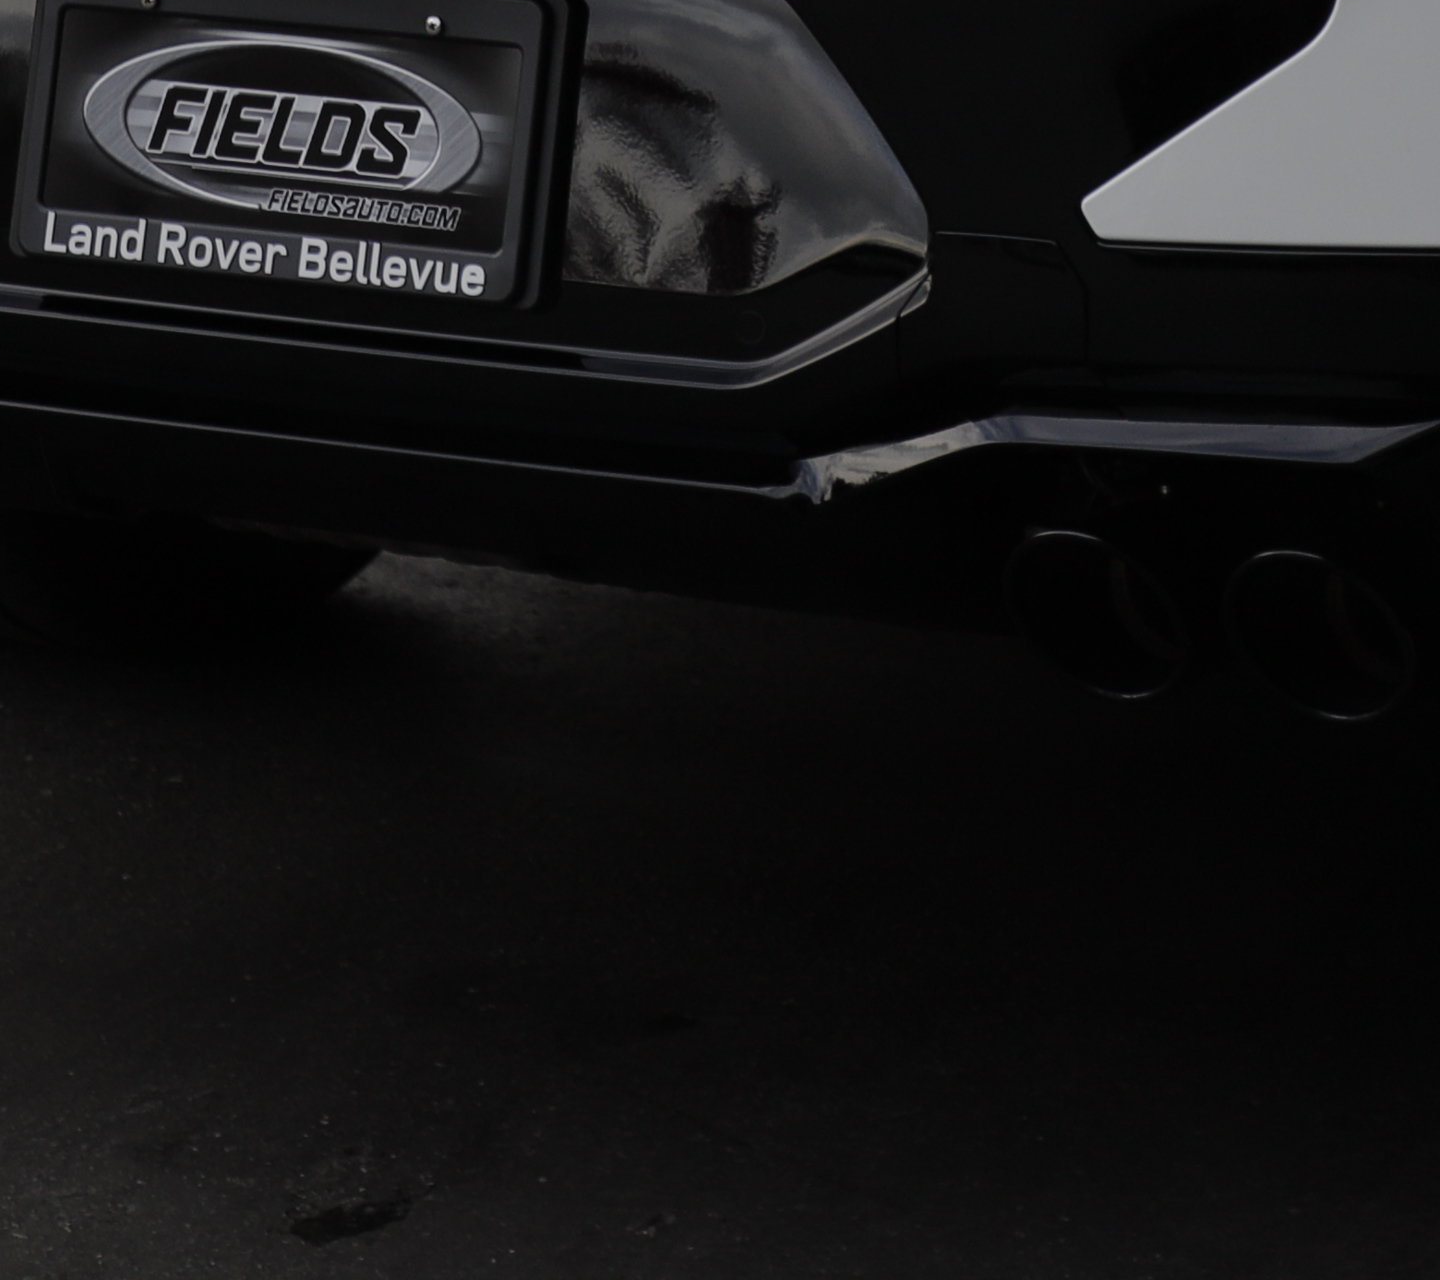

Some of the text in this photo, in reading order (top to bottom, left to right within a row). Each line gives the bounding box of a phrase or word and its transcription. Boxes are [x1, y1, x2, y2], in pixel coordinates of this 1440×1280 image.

[145, 85, 422, 179] FIELDS
[43, 210, 486, 297] Land Rover Bellevue
